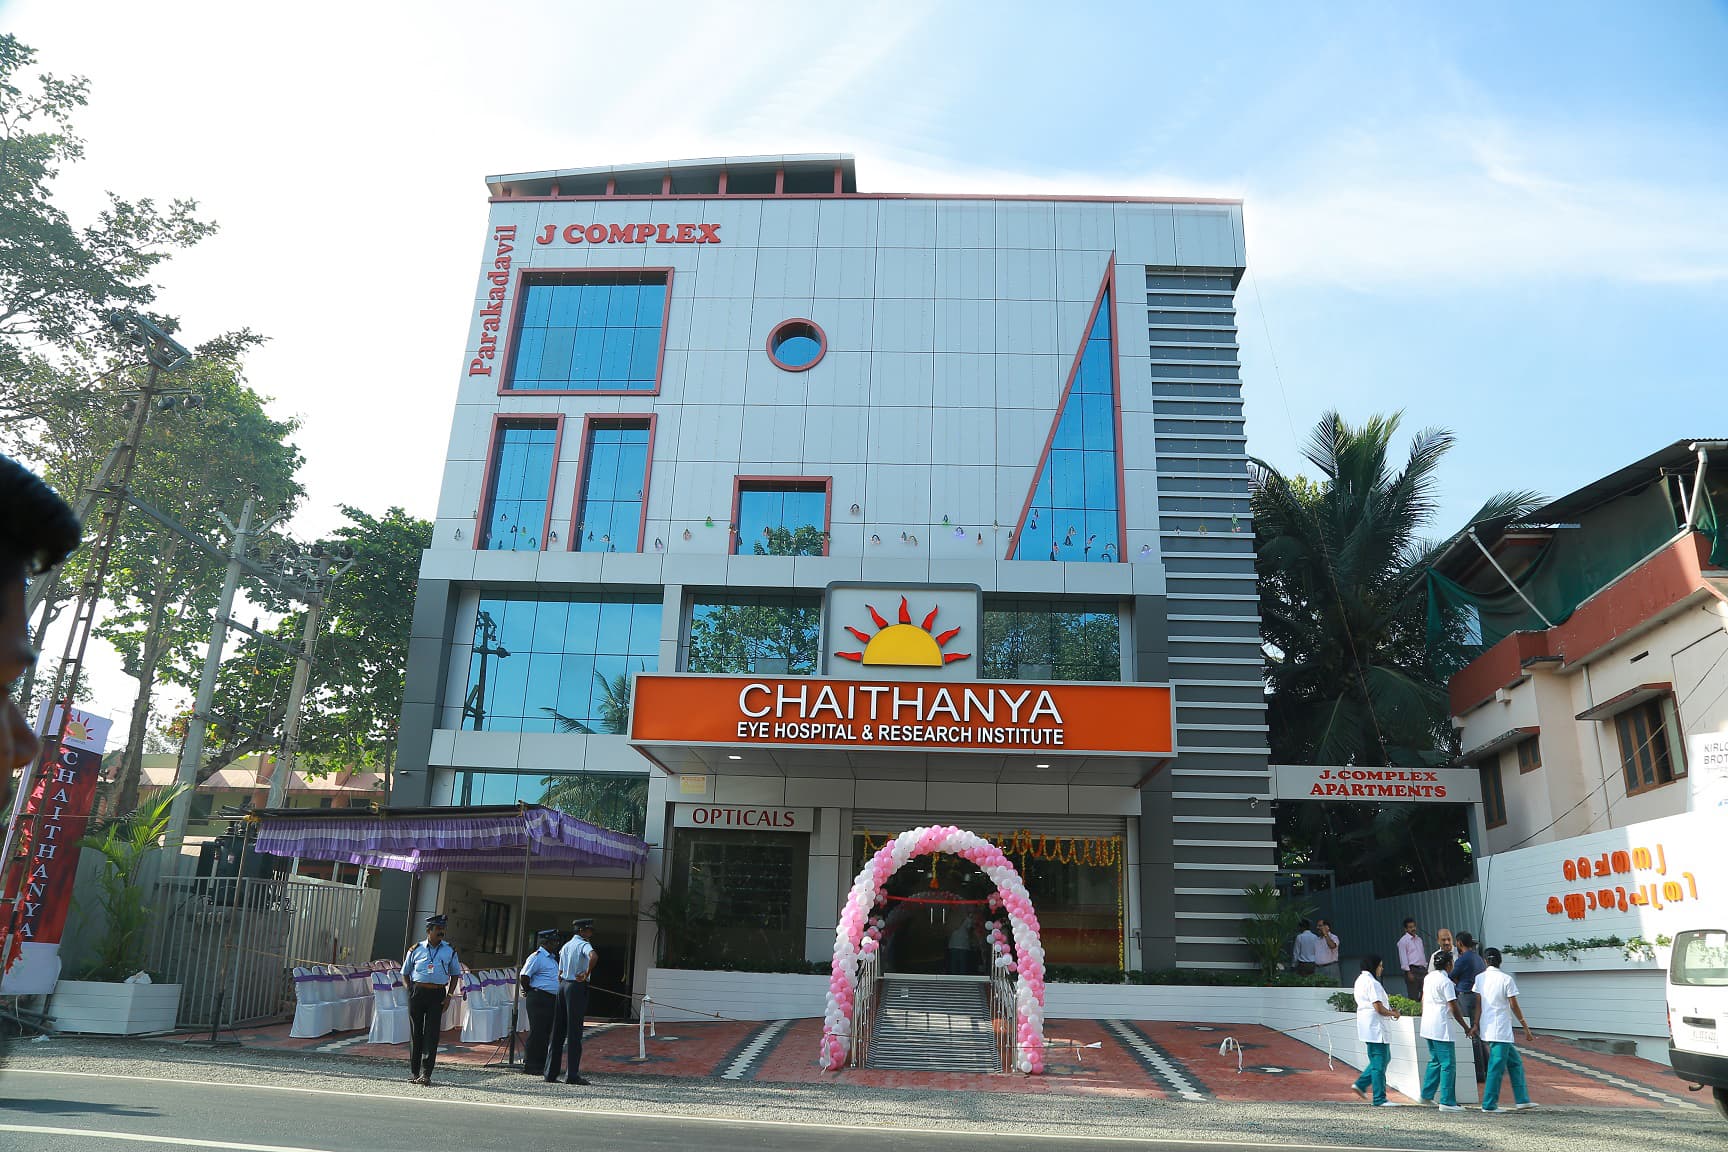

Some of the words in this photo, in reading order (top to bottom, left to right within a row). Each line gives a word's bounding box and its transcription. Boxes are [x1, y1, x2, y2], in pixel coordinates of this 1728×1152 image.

[535, 224, 557, 245] J
[562, 223, 722, 244] COMPLEX
[468, 224, 518, 377] Parakadavil
[739, 683, 1064, 724] CHAITHANYA
[737, 721, 770, 738] EYE
[774, 722, 857, 740] HOSPITAL
[861, 724, 874, 741] &
[878, 724, 972, 743] RESEARCH
[977, 726, 1064, 745] INSTITUTE
[1319, 769, 1438, 782] J.COMPLEX
[1310, 783, 1447, 798] APARTMENTS
[692, 807, 795, 828] OPTICALS
[20, 751, 79, 938] CHAITHANYA
